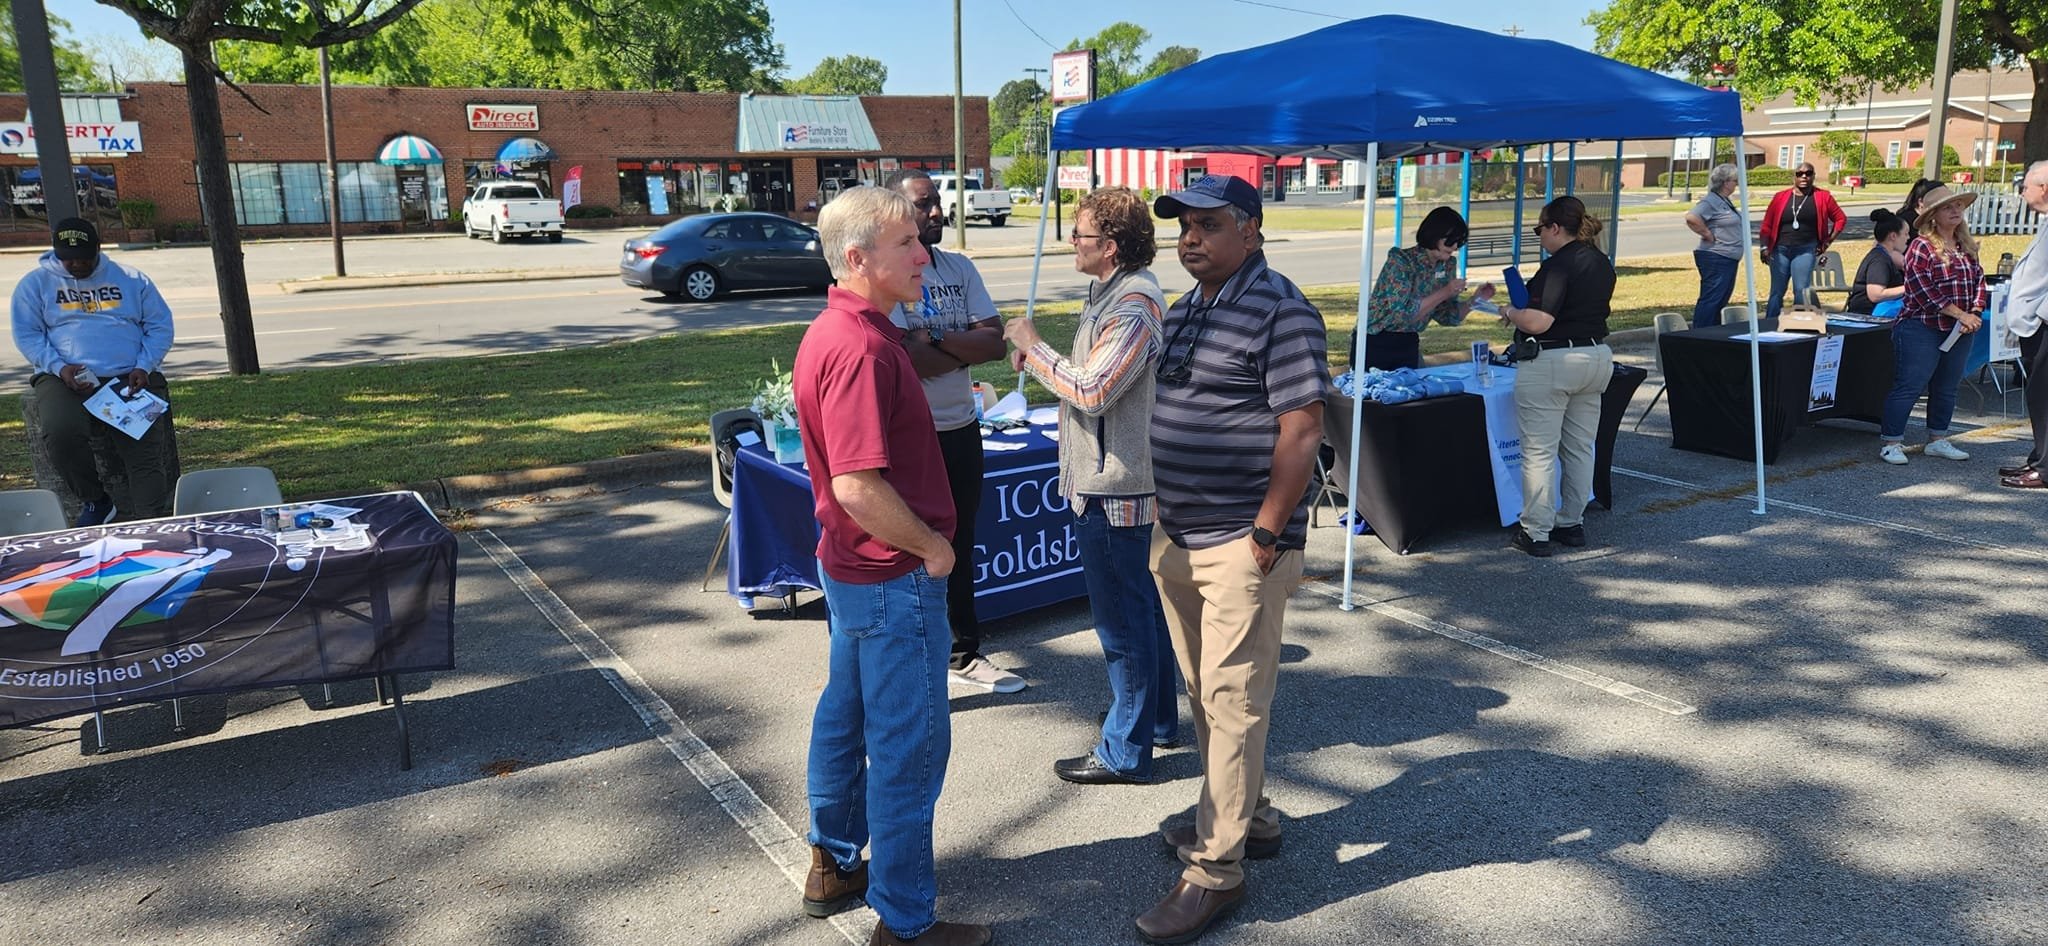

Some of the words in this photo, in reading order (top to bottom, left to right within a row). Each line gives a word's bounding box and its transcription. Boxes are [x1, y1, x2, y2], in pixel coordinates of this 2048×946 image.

[473, 108, 534, 122] Direct
[28, 126, 115, 138] LERTY
[808, 125, 832, 136] Furniture
[833, 125, 847, 136] Store
[98, 138, 135, 150] TAX
[56, 286, 122, 304] AGGIES
[1494, 439, 1521, 449] Literac
[53, 531, 90, 544] OF
[973, 524, 1080, 584] Goldsb
[0, 662, 143, 687] Established
[148, 643, 206, 673] 1950
